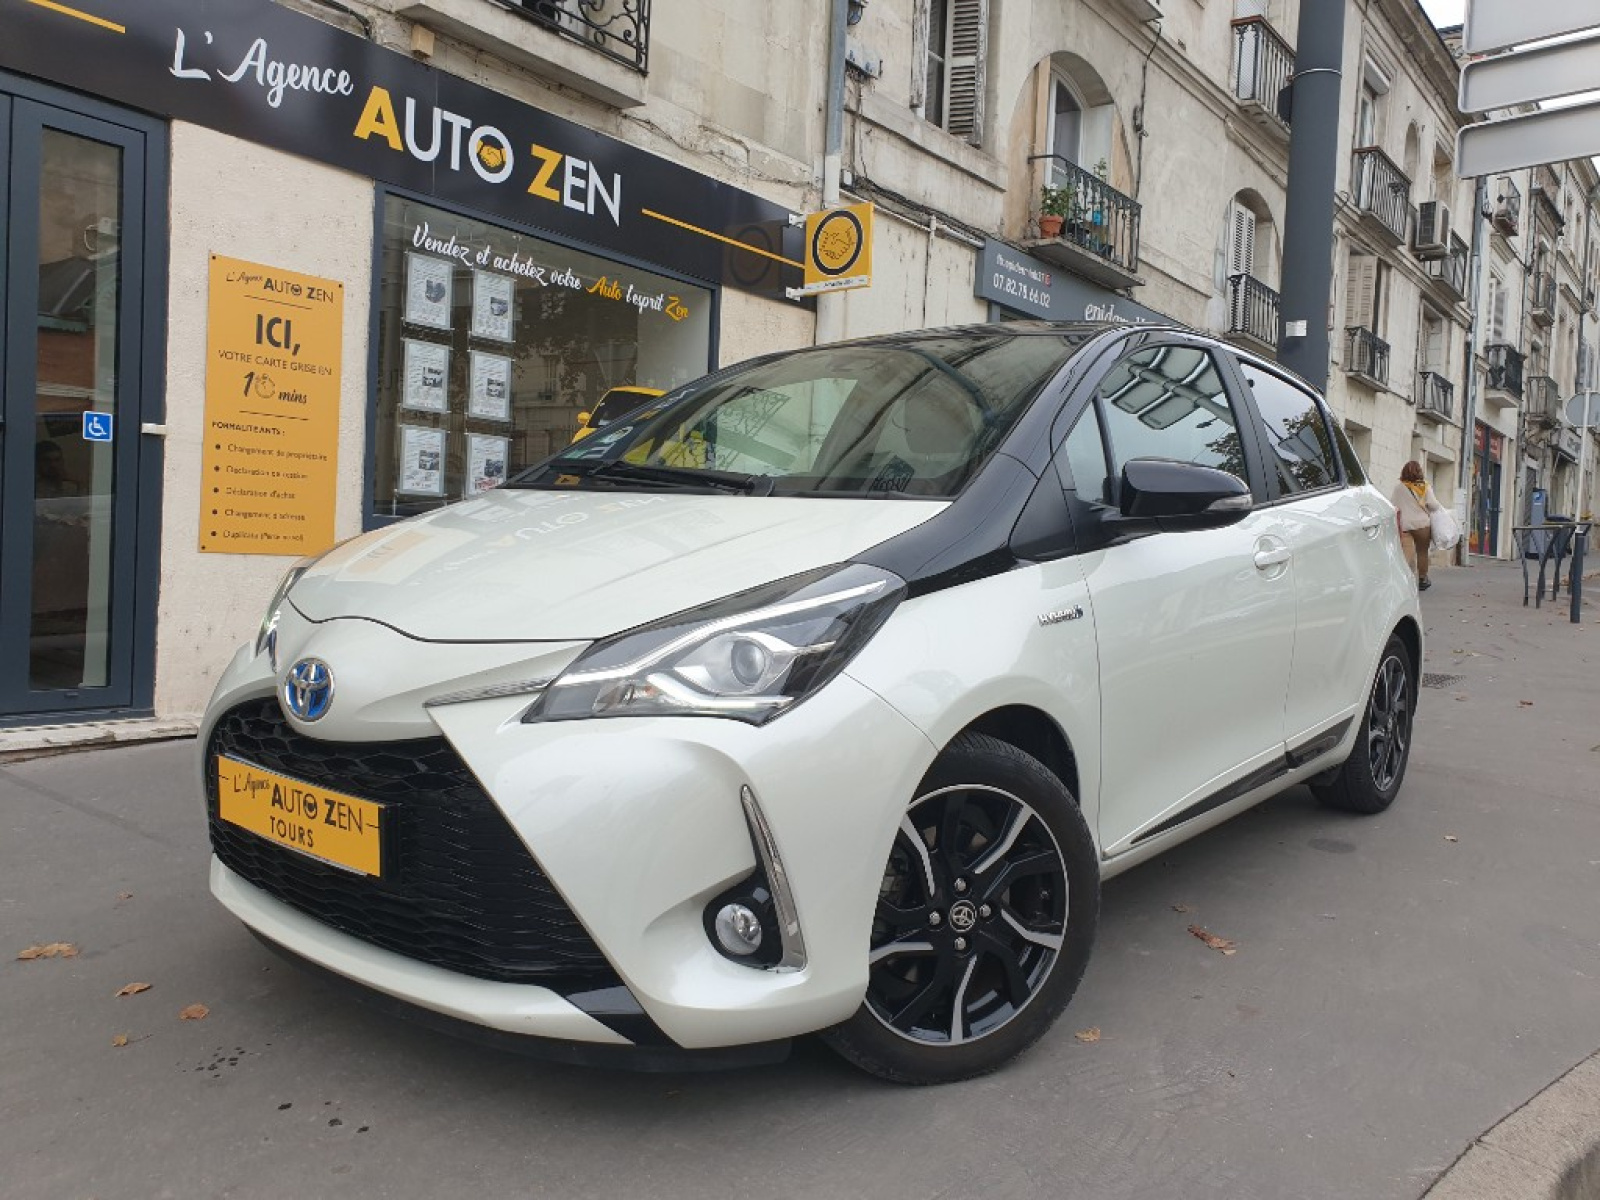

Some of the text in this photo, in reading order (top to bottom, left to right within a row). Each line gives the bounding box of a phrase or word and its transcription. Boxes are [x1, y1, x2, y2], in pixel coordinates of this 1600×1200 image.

[353, 85, 514, 183] AUTO
[528, 143, 622, 227] ZEN
[263, 278, 302, 296] AUTO
[306, 287, 334, 303] ZEN
[412, 222, 474, 267] Vendez
[476, 245, 490, 265] et
[493, 252, 548, 287] achetez
[550, 267, 582, 290] votre
[586, 276, 622, 301] Auto
[665, 296, 690, 321] Zen
[256, 313, 301, 356] ICI,
[218, 350, 332, 376] VOTRE CARTE GRISE EN
[271, 783, 318, 820] AUTO
[324, 797, 363, 835] ZEN
[270, 816, 314, 848] TOURS
